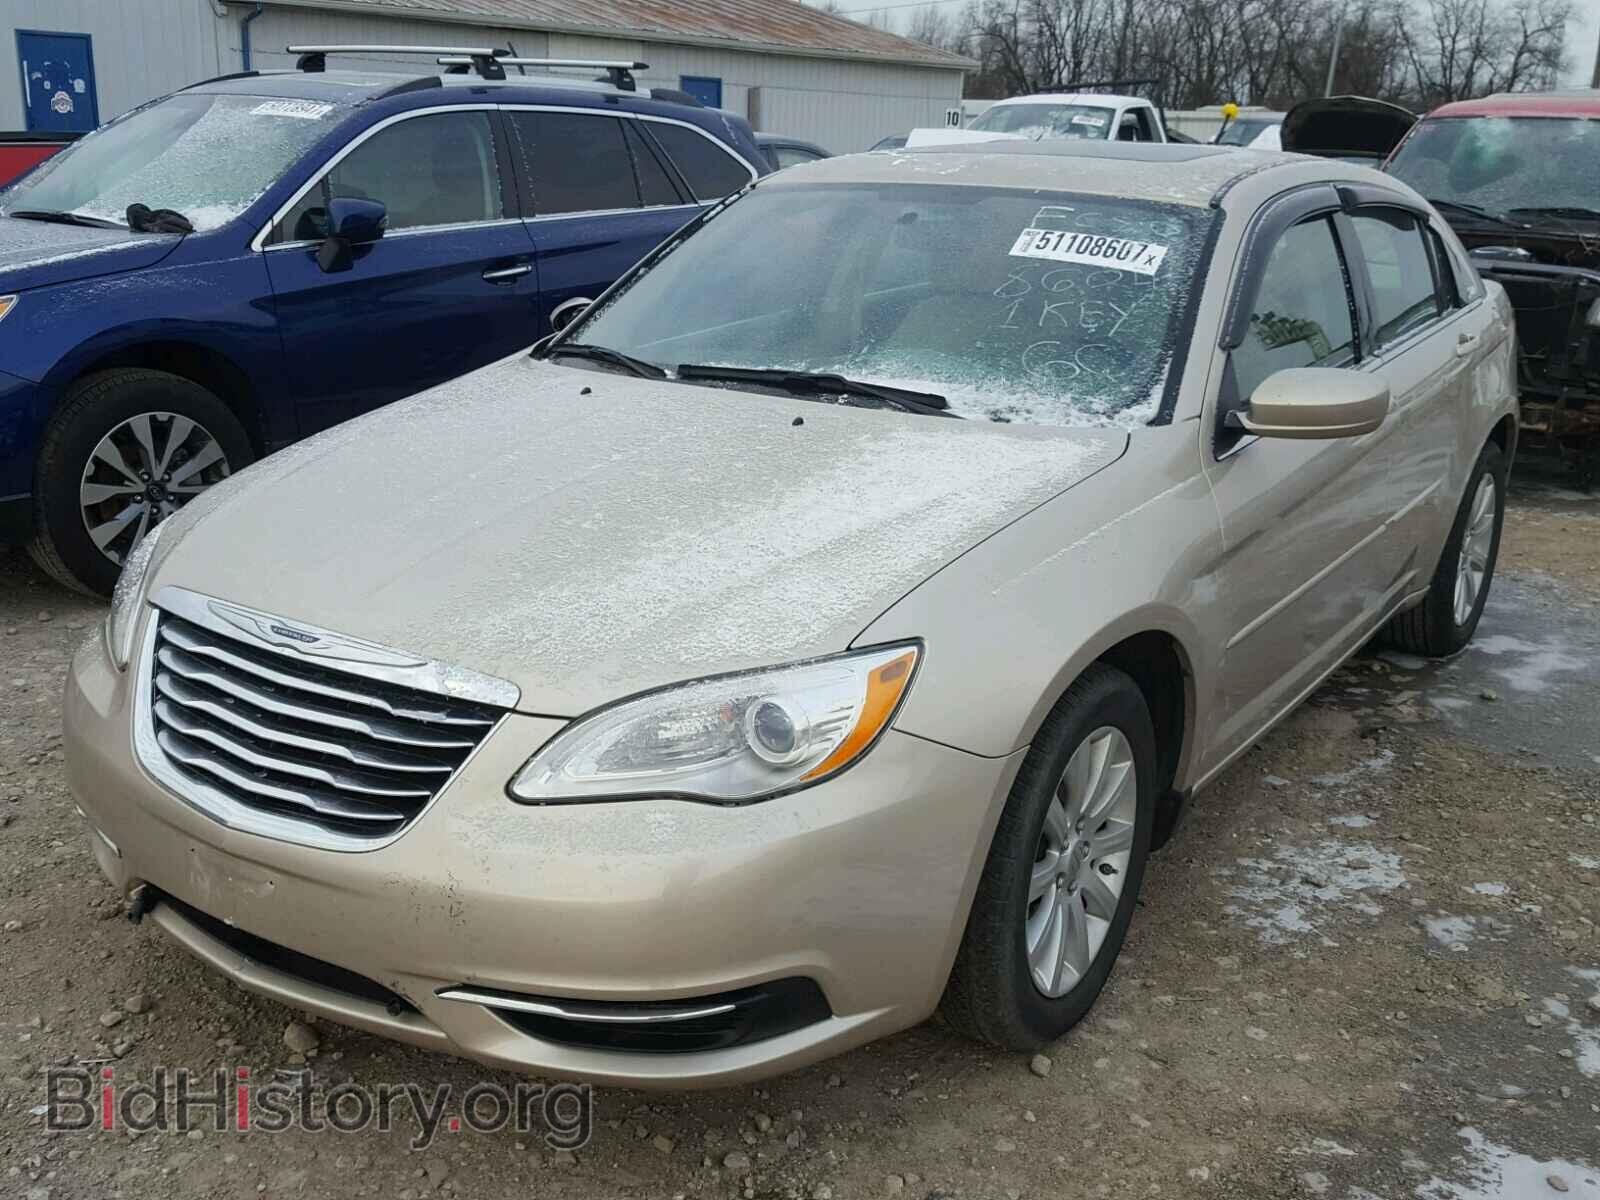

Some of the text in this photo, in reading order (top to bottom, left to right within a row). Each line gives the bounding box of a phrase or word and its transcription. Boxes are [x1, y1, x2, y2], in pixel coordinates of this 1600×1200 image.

[946, 111, 959, 126] 10
[1035, 231, 1149, 262] 51108607
[1038, 295, 1153, 337] KEY
